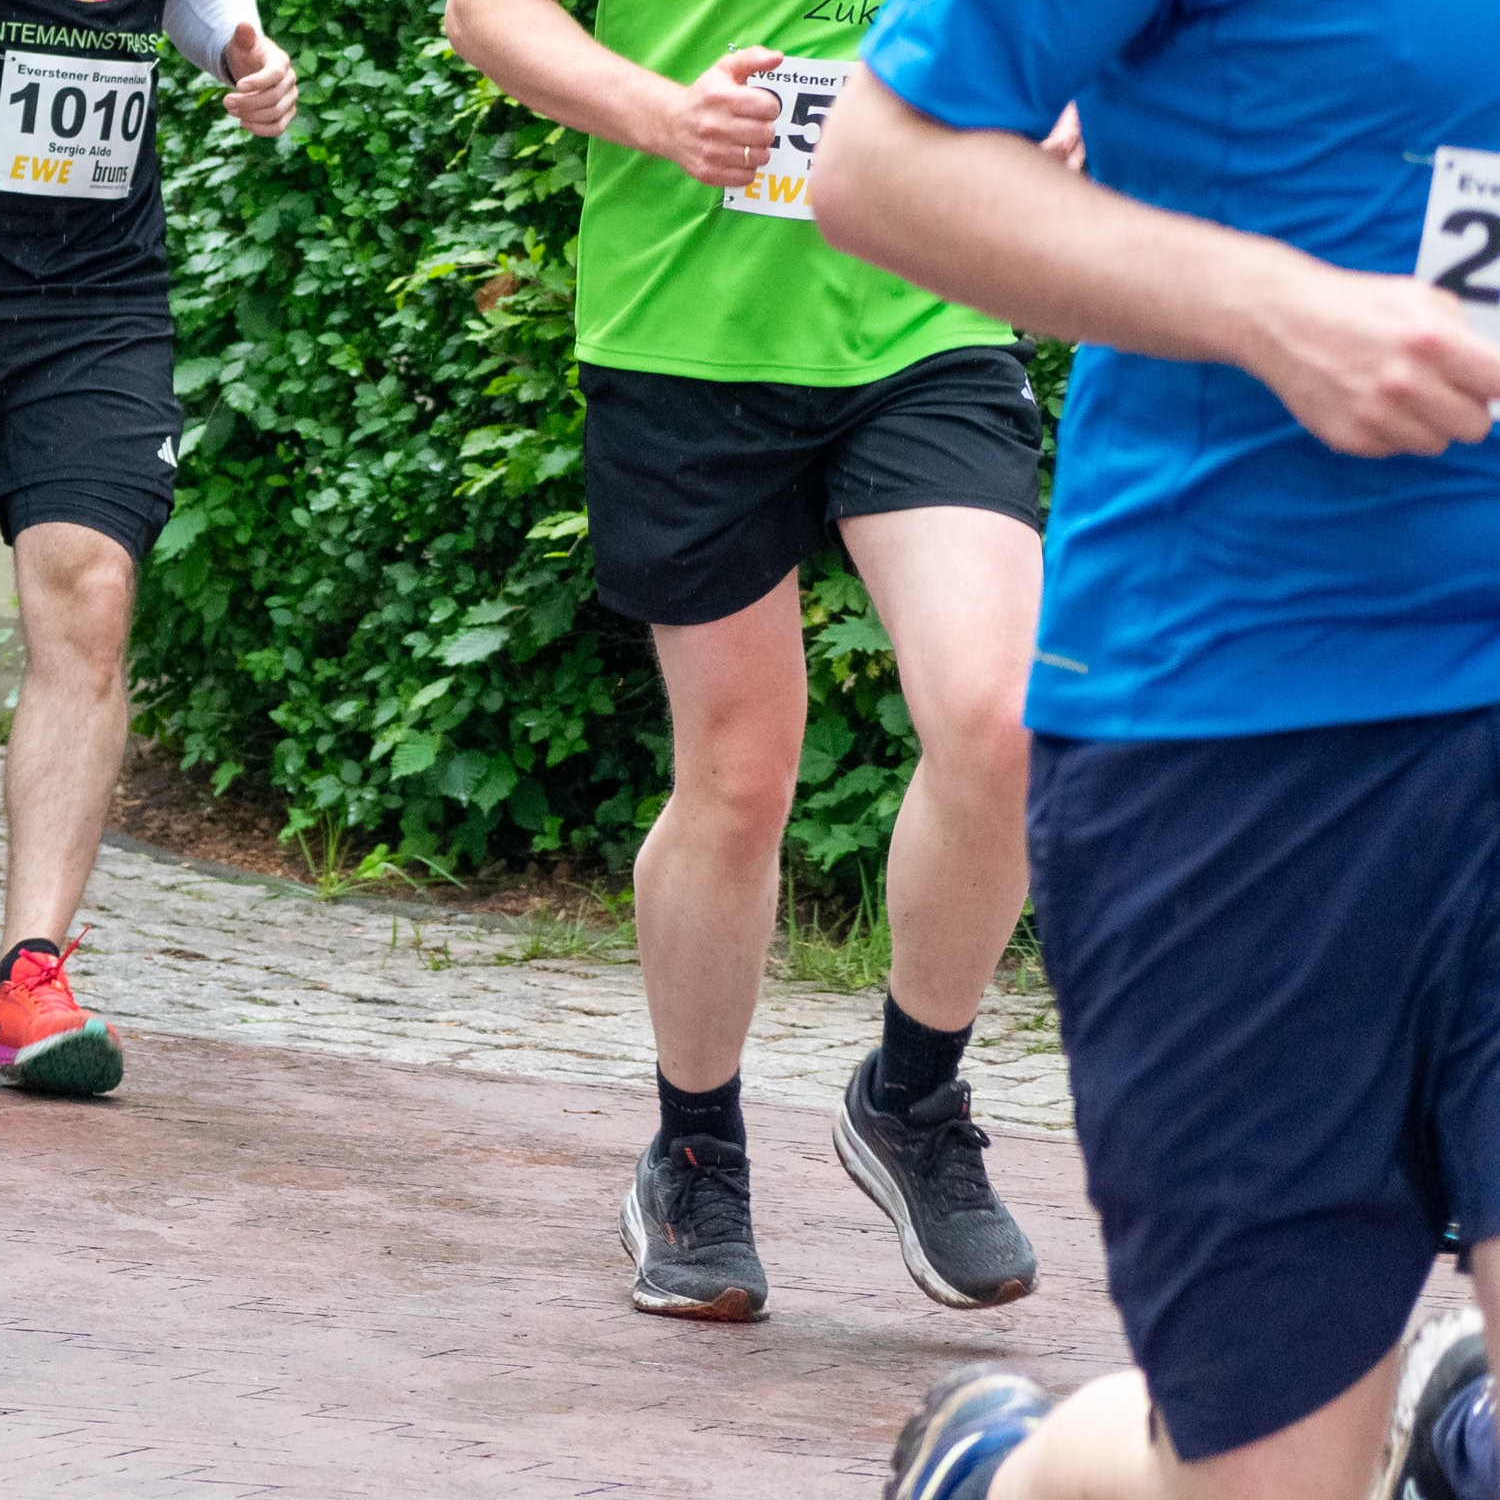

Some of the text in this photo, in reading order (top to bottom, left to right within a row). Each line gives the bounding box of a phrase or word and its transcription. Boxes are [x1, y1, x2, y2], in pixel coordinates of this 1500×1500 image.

[18, 64, 89, 82] Everstener
[9, 82, 145, 142] 1010
[48, 142, 112, 157] Sergio Aldo
[9, 155, 128, 184] EWE bruns
[744, 172, 813, 206] EW
